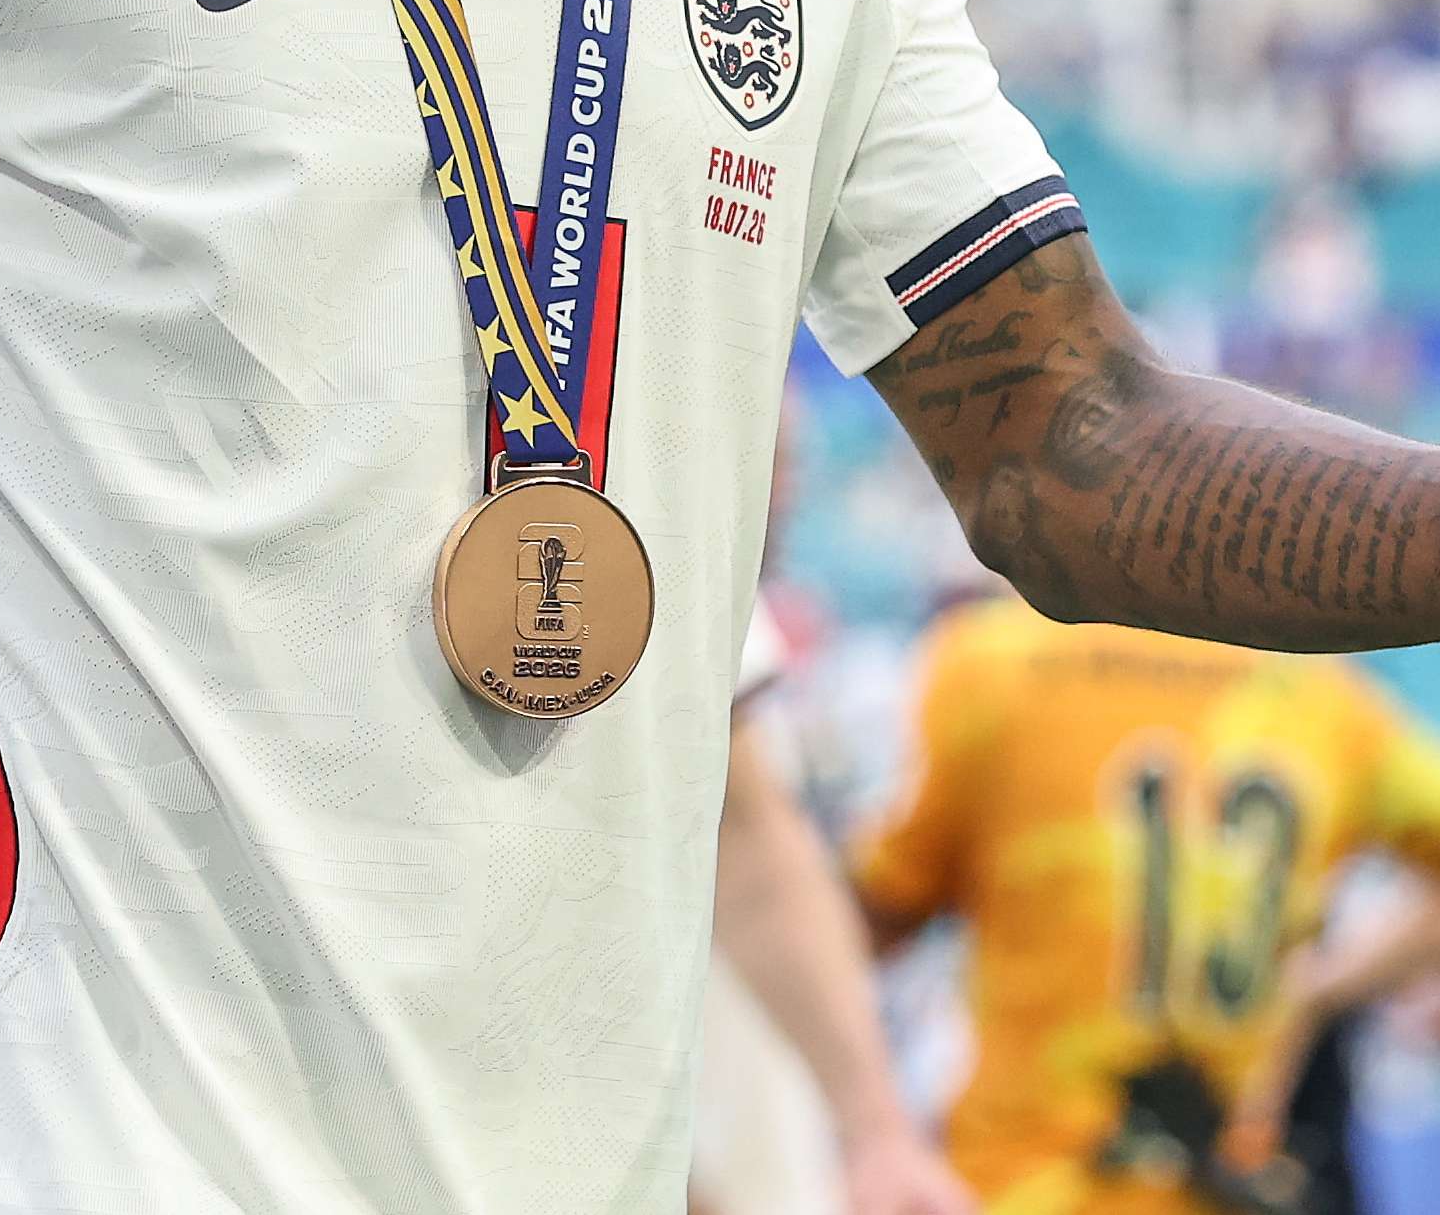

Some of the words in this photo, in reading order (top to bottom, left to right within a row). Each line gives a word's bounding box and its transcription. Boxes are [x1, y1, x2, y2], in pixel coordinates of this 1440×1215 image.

[571, 38, 607, 126] CUP
[707, 146, 777, 201] FRANCE
[550, 133, 596, 288] WORLD
[703, 194, 767, 246] 18.07.26
[545, 299, 577, 391] IFA
[535, 616, 566, 632] FIFA
[513, 645, 558, 658] WORLD
[558, 646, 582, 659] CUP
[513, 658, 582, 679] 2026
